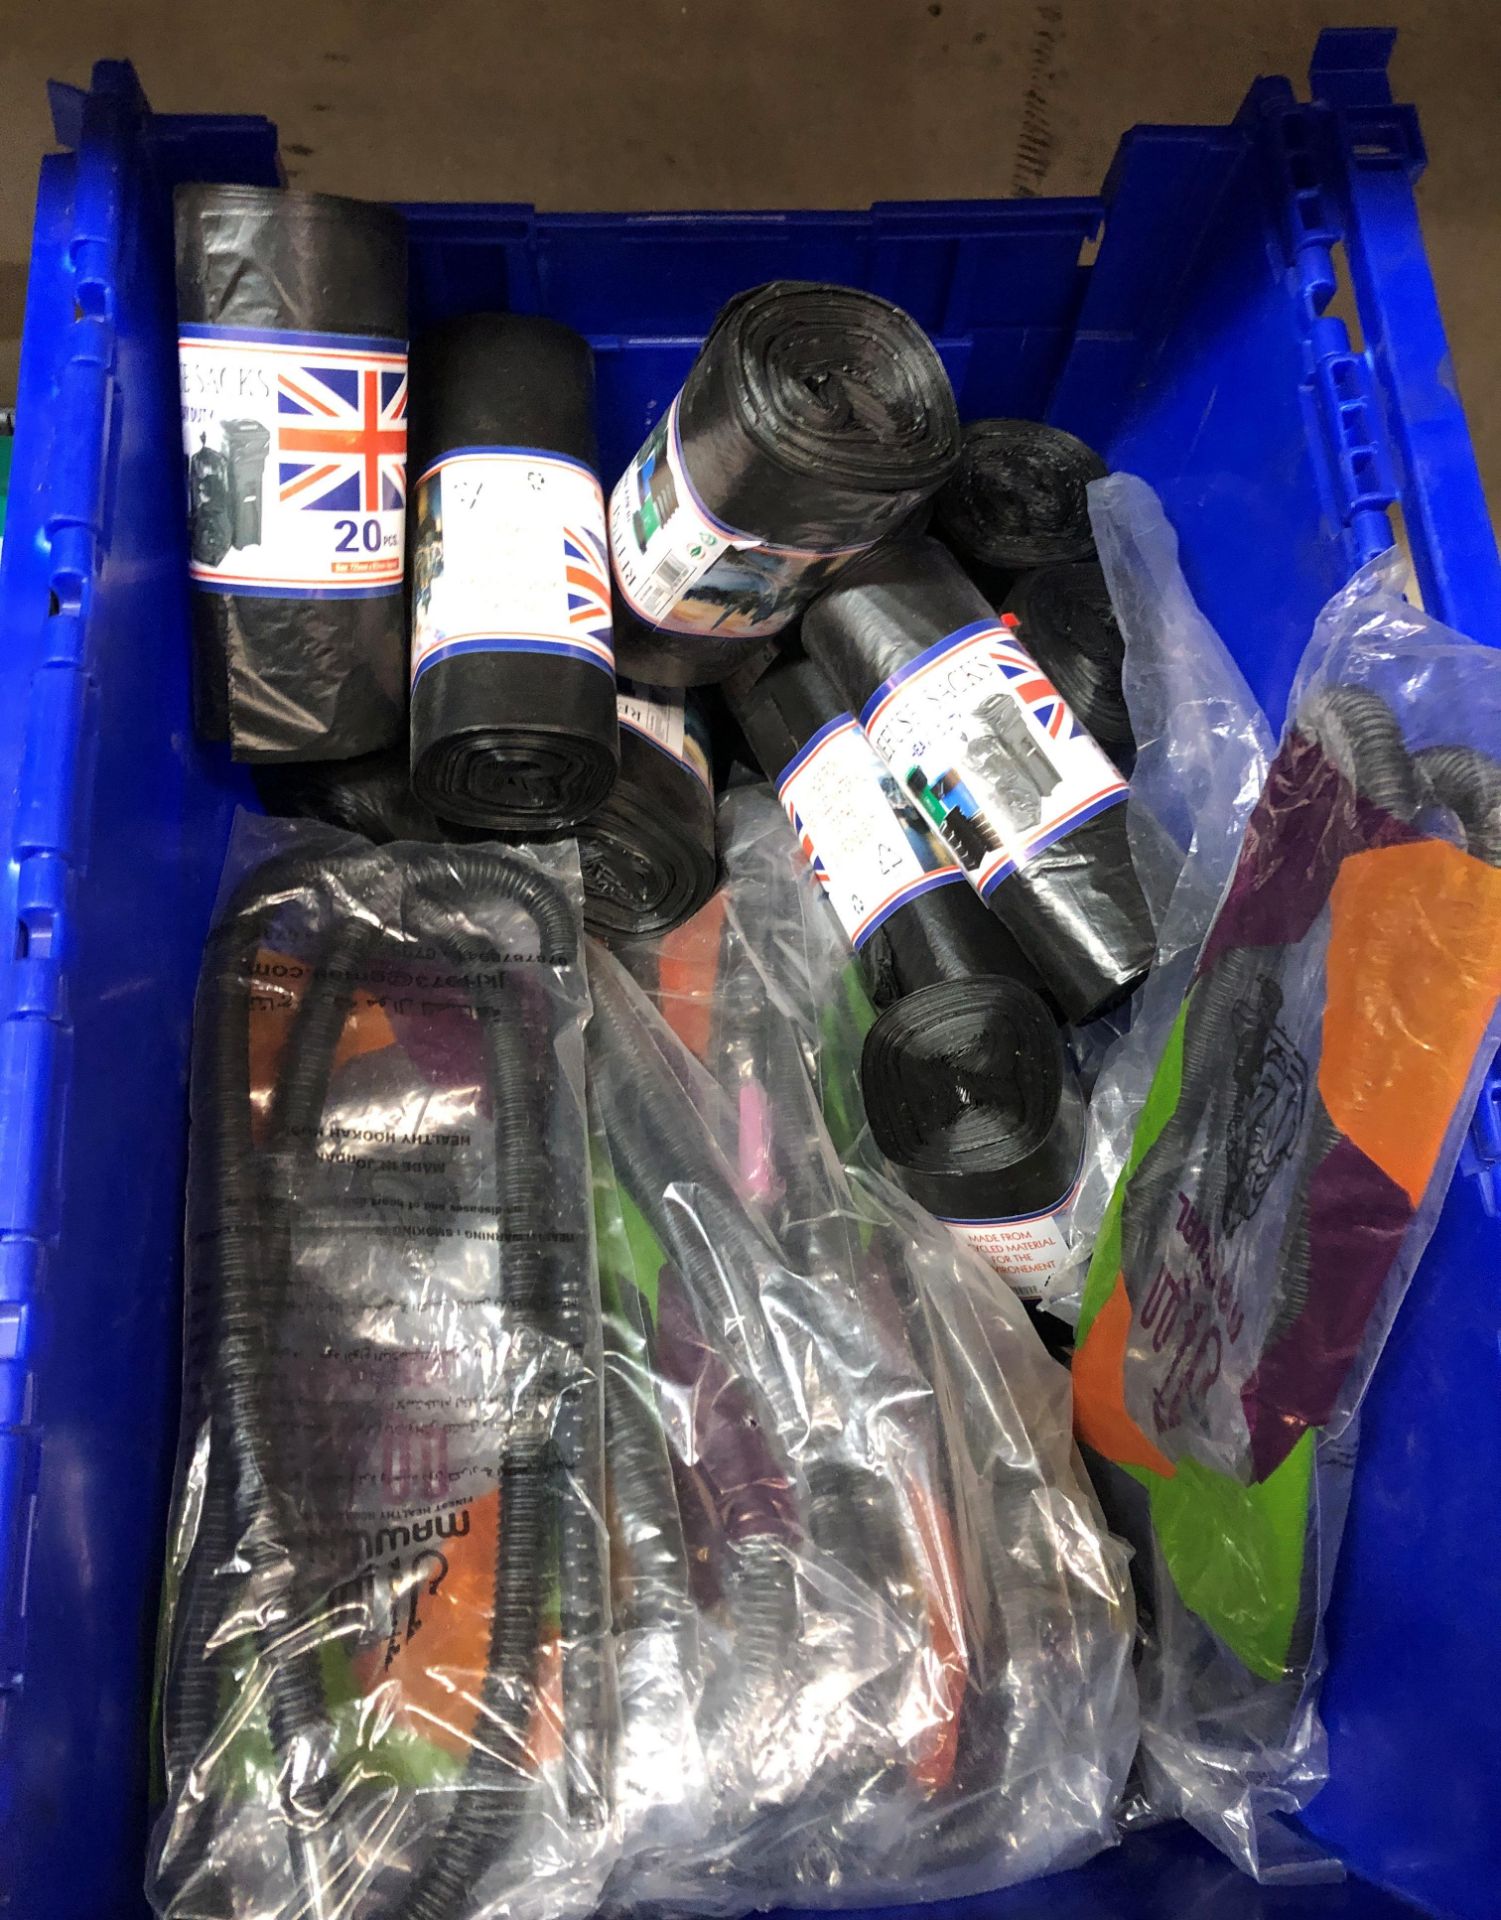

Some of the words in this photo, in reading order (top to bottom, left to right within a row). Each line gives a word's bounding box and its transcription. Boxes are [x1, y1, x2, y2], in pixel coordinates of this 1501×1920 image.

[334, 518, 382, 553] 20
[329, 1128, 396, 1143] HOOKAH
[400, 1133, 472, 1147] HEALTHY
[401, 1161, 446, 1174] MADE
[968, 1234, 998, 1242] MADE
[1000, 1231, 1032, 1241] FROM
[1006, 1237, 1056, 1252] MATERIAL
[992, 1255, 1012, 1264] FOR
[1014, 1253, 1033, 1262] THE
